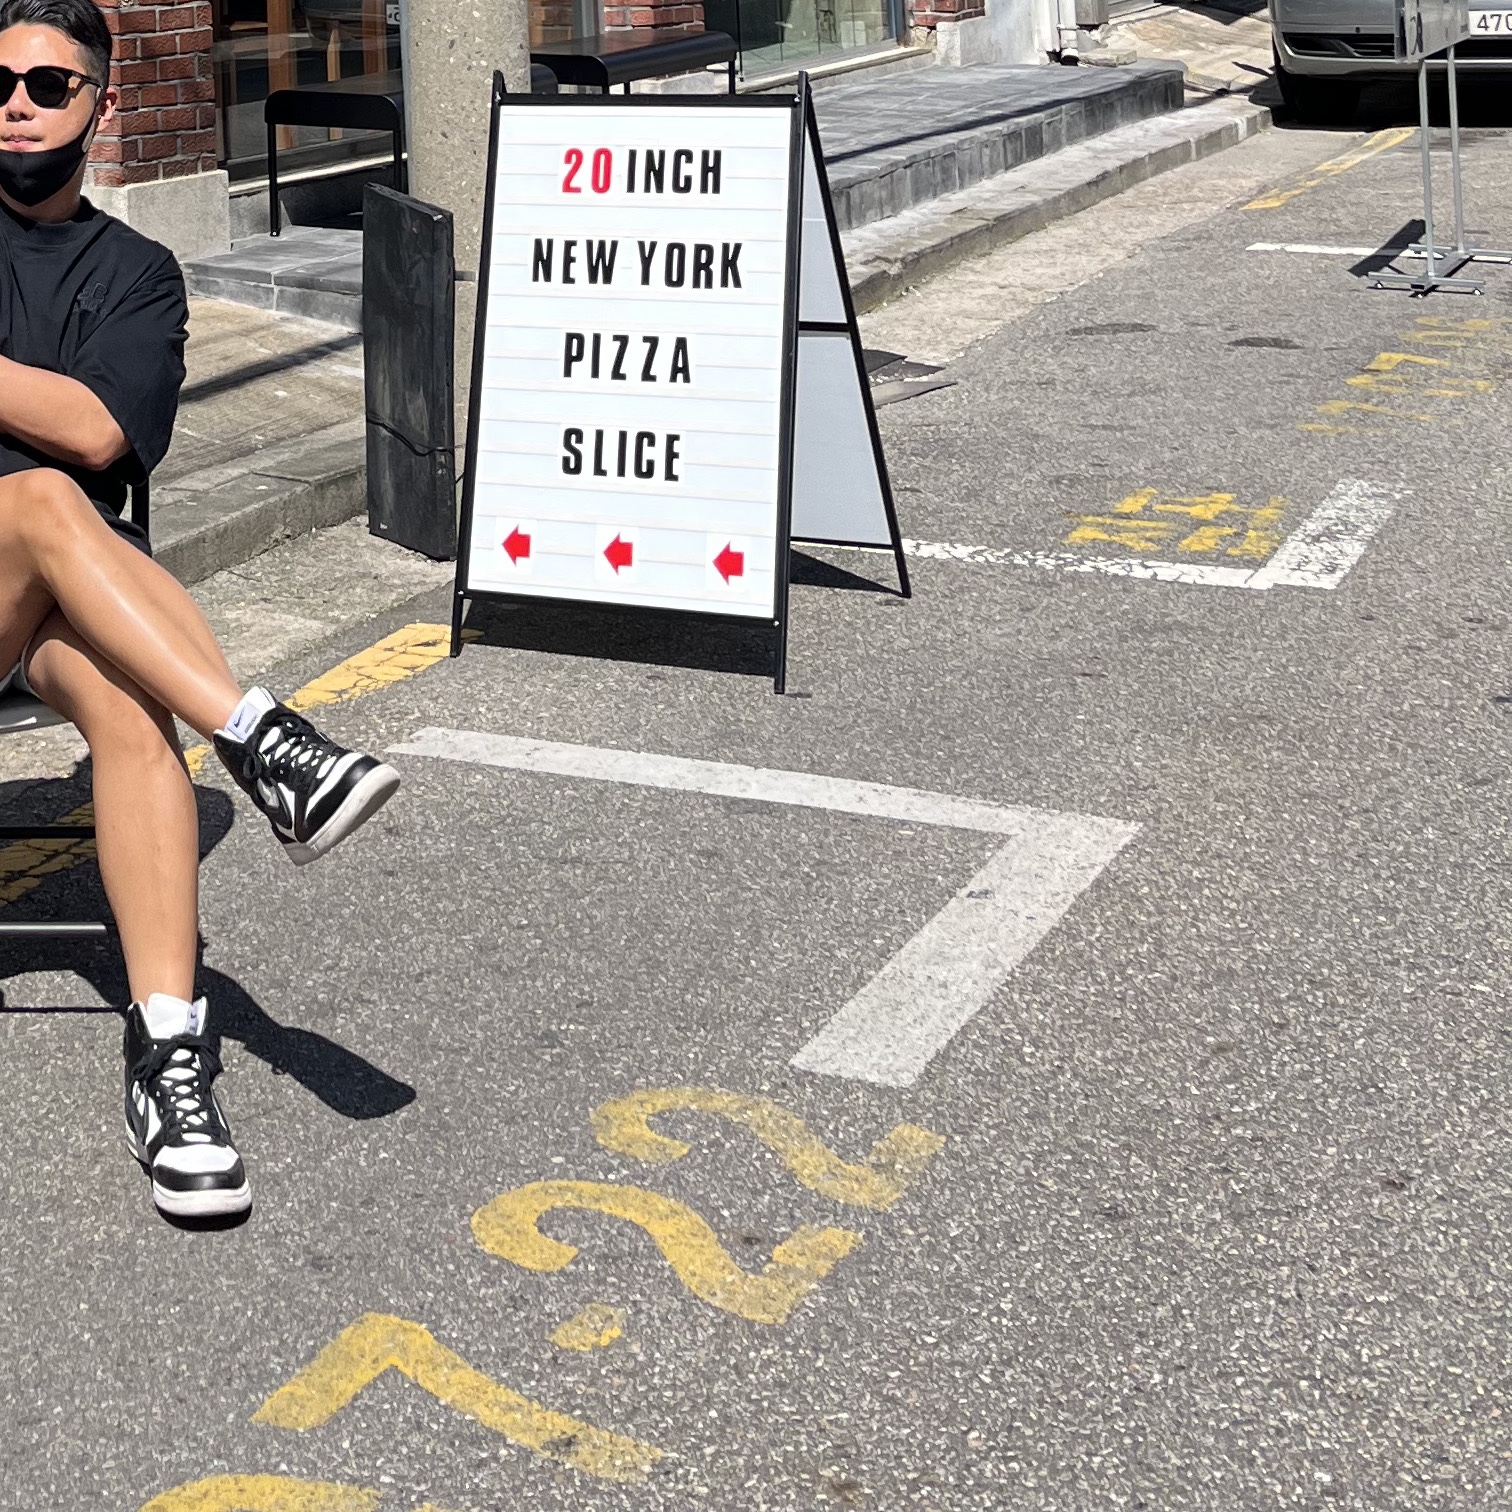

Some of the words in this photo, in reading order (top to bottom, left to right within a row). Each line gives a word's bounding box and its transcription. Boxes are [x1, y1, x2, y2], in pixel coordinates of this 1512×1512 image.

[561, 147, 613, 194] 20
[626, 149, 722, 195] INCH
[532, 238, 618, 285] NEW
[637, 241, 743, 289] YORK
[563, 332, 691, 384] PIZZA
[561, 427, 680, 482] SLICE
